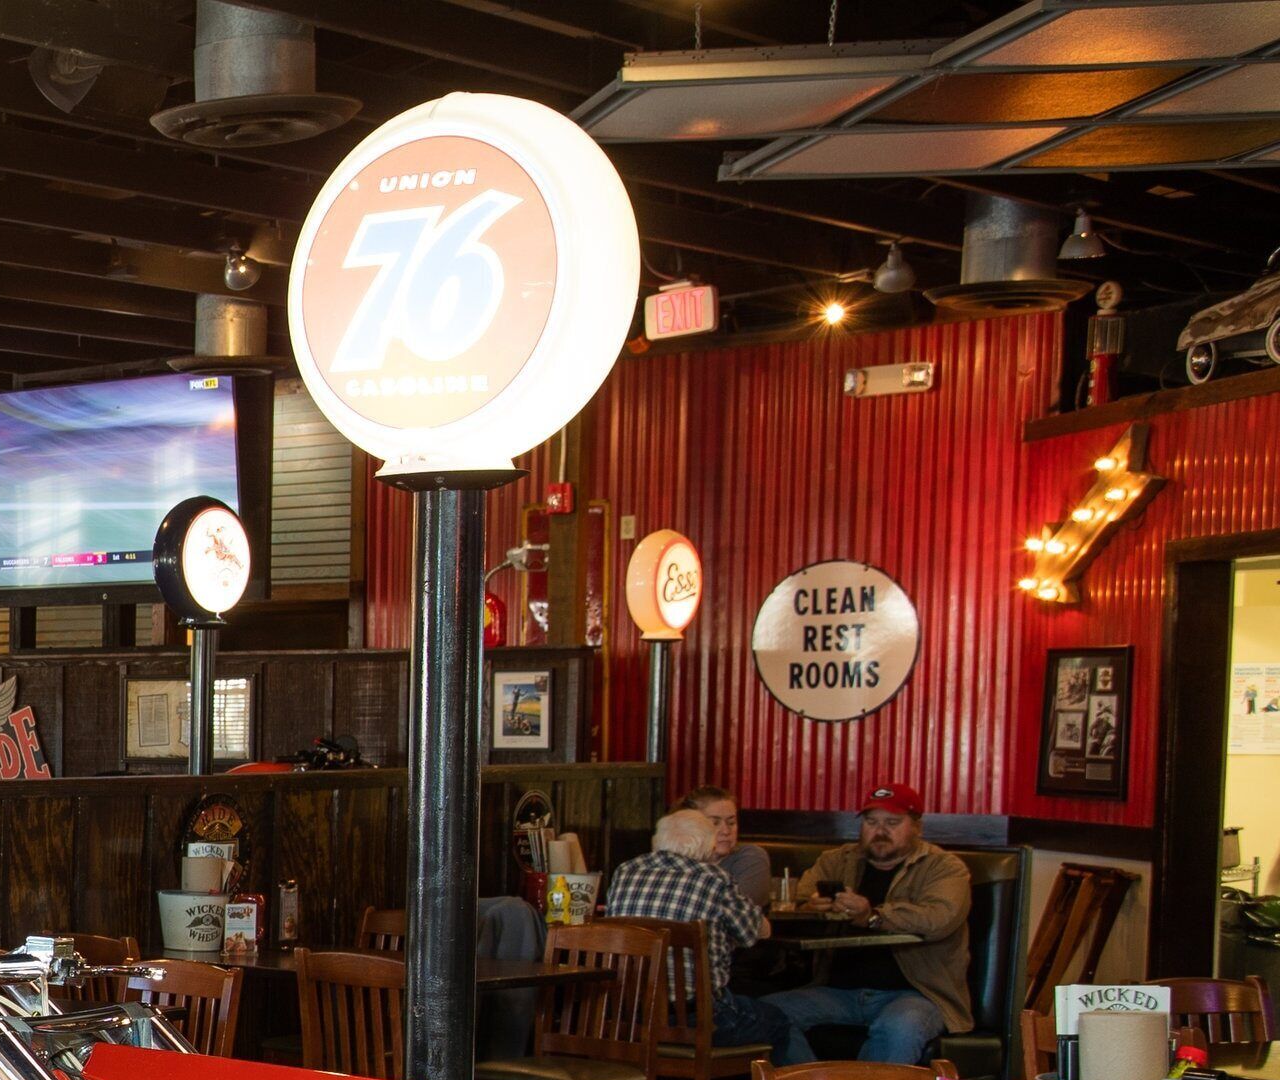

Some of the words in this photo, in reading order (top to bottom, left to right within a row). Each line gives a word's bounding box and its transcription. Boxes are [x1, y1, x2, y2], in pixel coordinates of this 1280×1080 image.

[379, 168, 478, 193] UNION
[328, 189, 524, 373] 76
[656, 289, 706, 334] EXIT
[345, 375, 489, 397] GASOLINE
[794, 586, 875, 615] CLEAN
[803, 624, 865, 652] REST
[789, 661, 880, 689] ROOMS
[192, 844, 225, 858] WICKED
[188, 929, 221, 943] WHEEL
[1078, 987, 1159, 1011] WICKED
